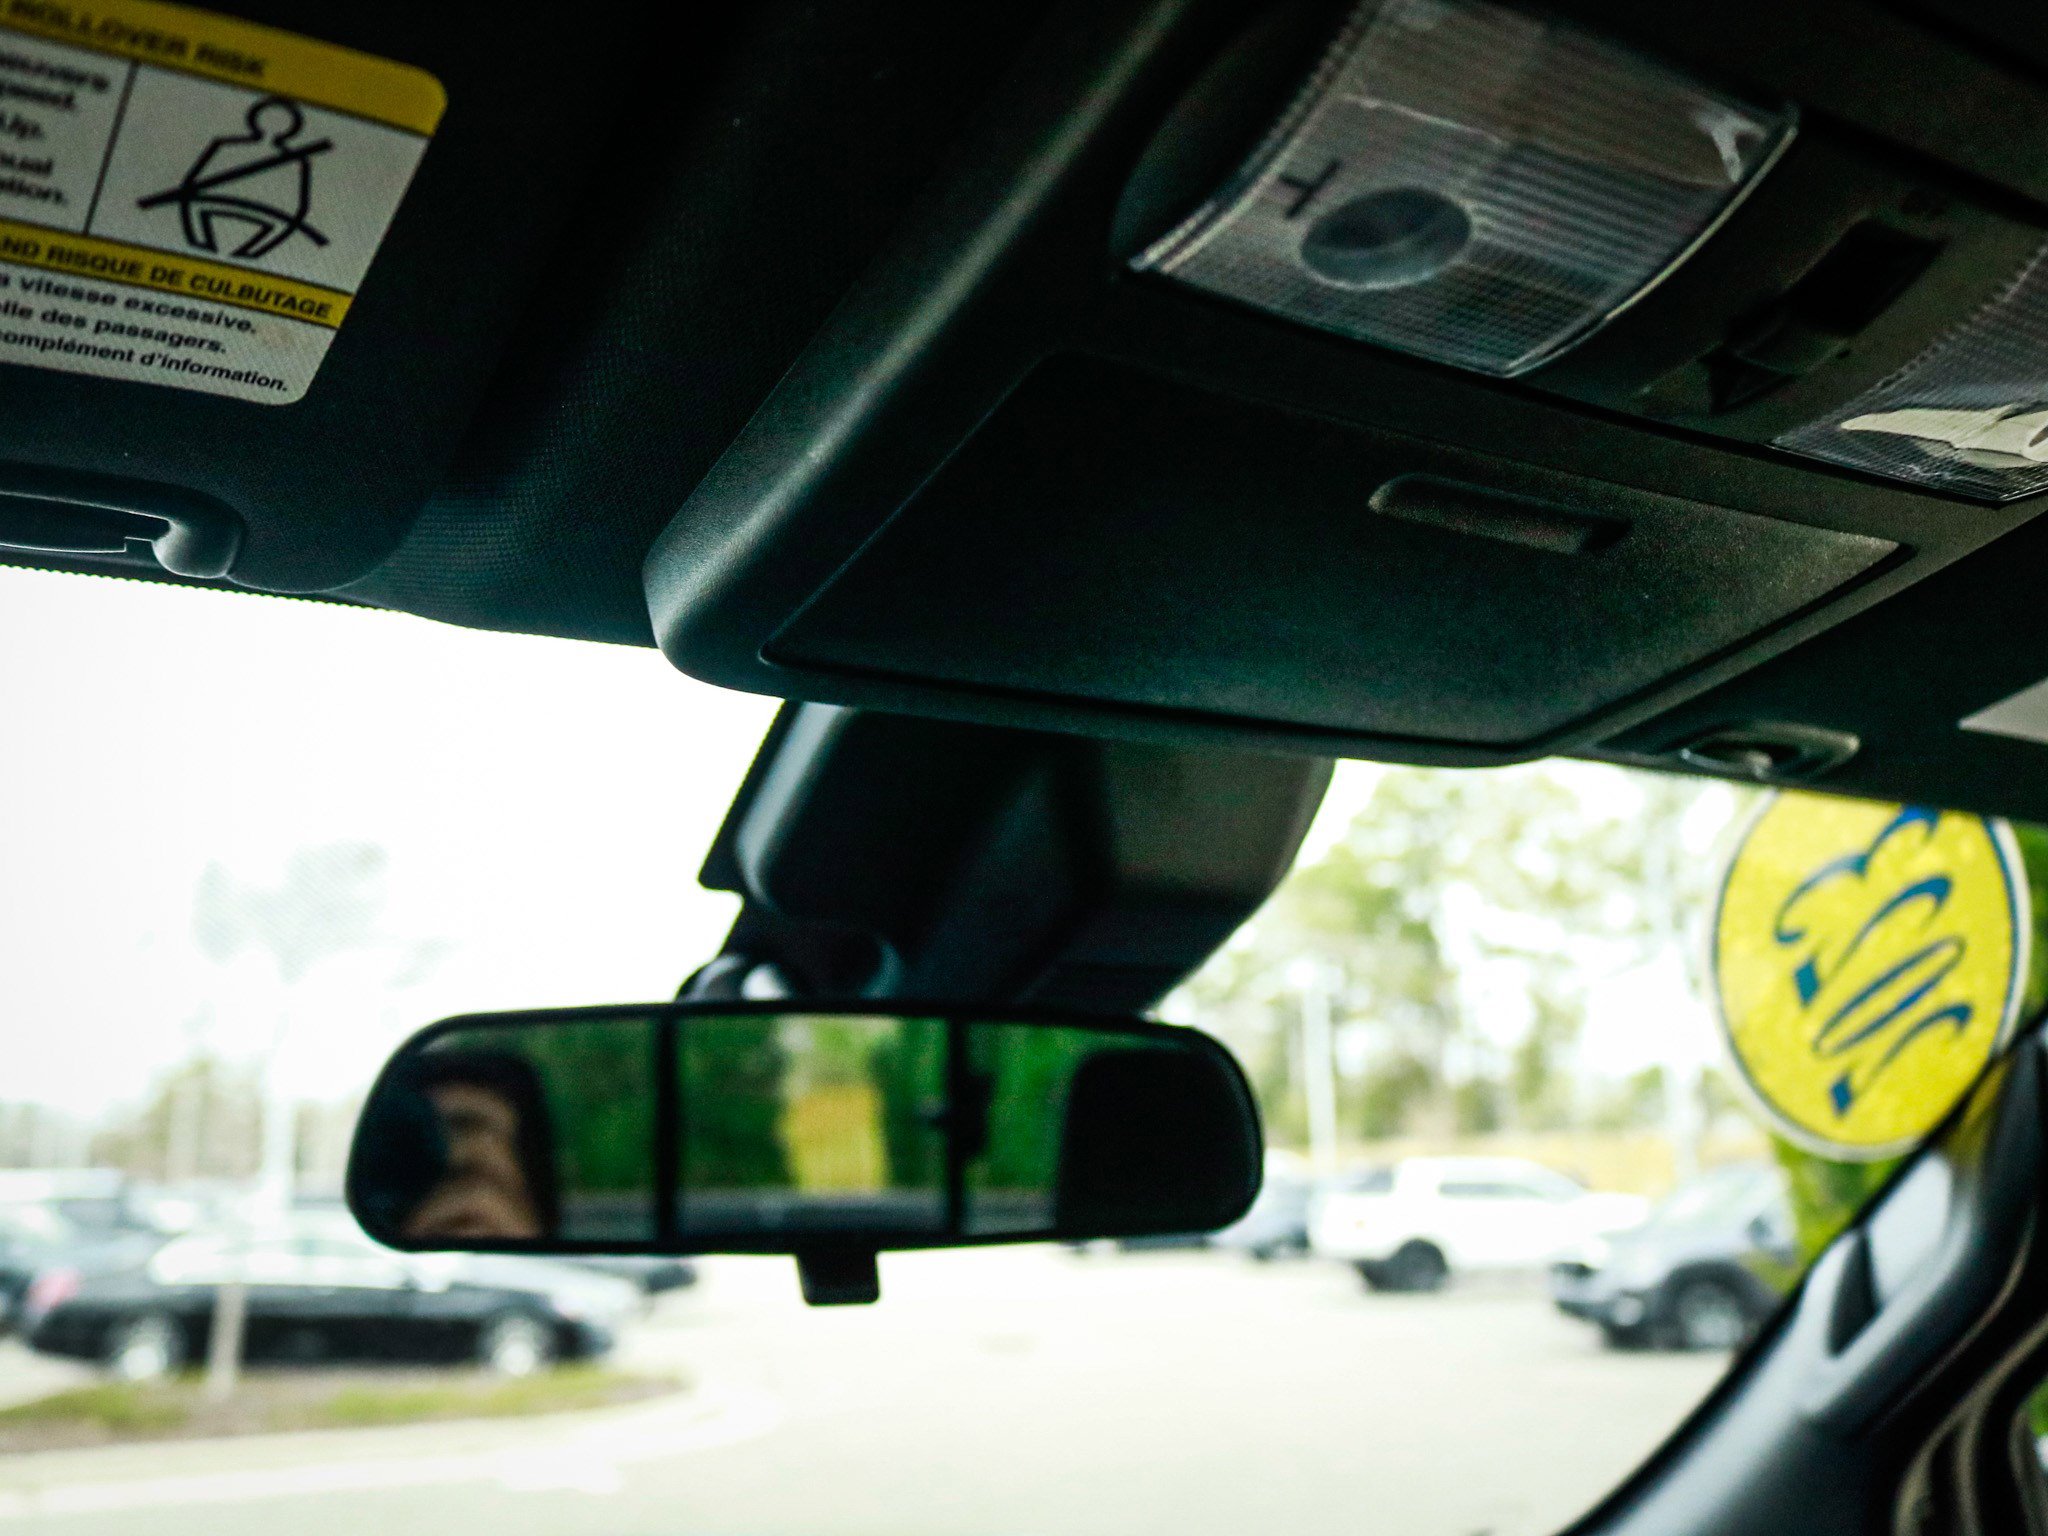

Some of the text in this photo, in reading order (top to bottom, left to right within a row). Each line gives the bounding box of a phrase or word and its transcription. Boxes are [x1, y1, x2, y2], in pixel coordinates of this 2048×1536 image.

[9, 0, 264, 79] ROLLOVER RISK
[20, 276, 117, 306] vitesse
[125, 297, 256, 335] excessive.
[47, 244, 143, 279] RISQUE
[150, 265, 185, 287] DE
[189, 271, 334, 319] CULBUTAGE
[0, 299, 226, 354] lle des passagers.
[0, 328, 288, 392] omplément d'information.
